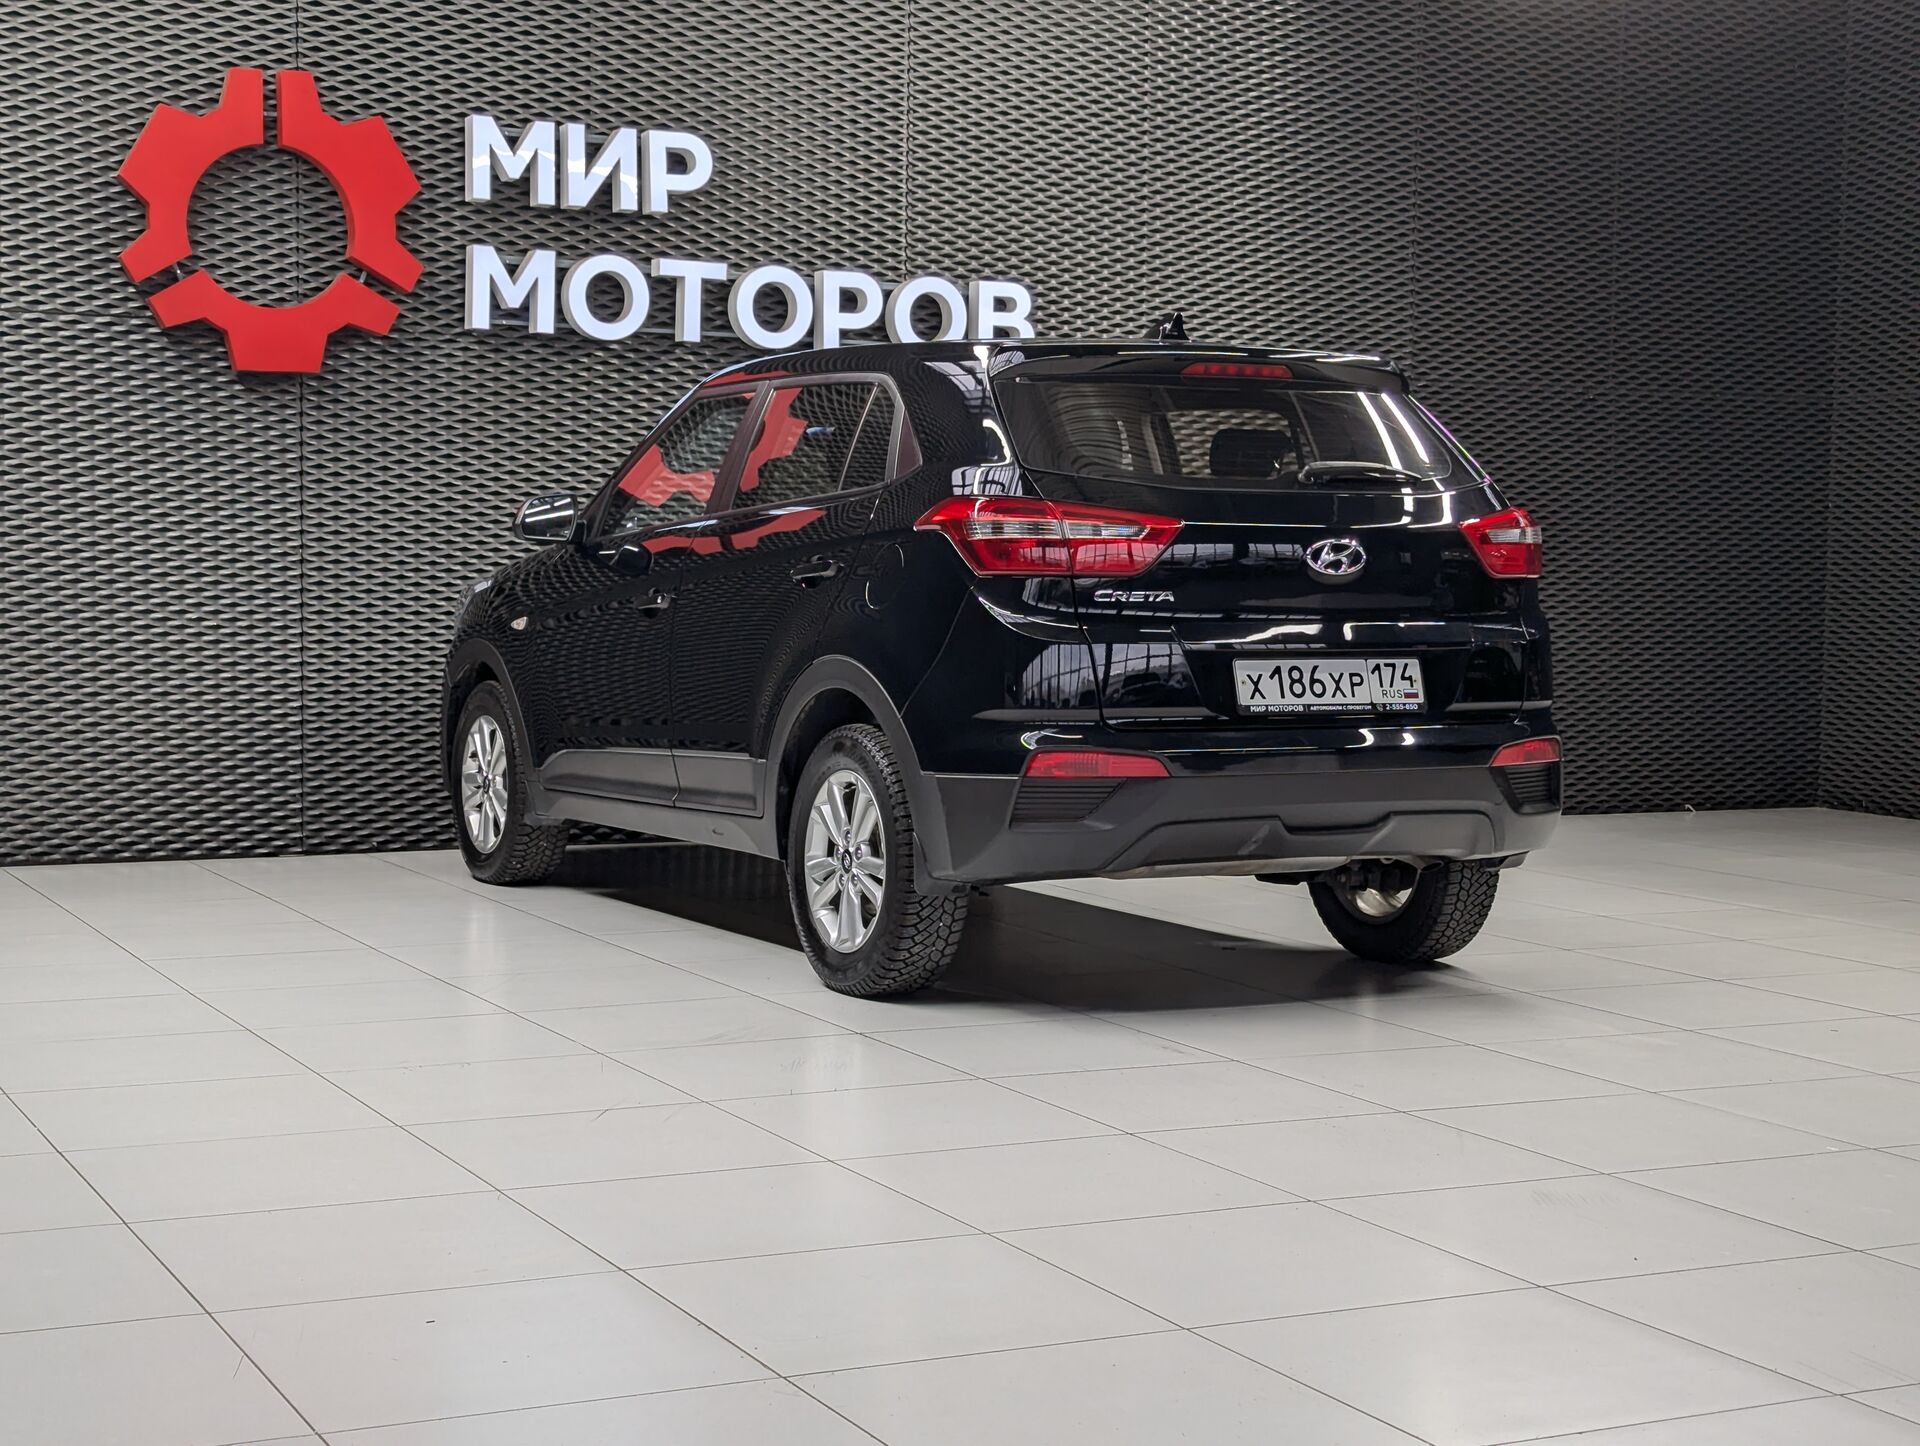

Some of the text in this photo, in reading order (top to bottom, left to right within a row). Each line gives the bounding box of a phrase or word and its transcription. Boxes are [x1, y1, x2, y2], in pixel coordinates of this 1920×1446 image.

[464, 114, 714, 215] МИР
[464, 244, 1035, 350] МОТОРОВ
[1094, 588, 1175, 602] CRETA
[1246, 662, 1414, 700] Х186ХР 174
[1381, 688, 1403, 699] RUS
[1250, 704, 1304, 713] МИР МОТОРОВ
